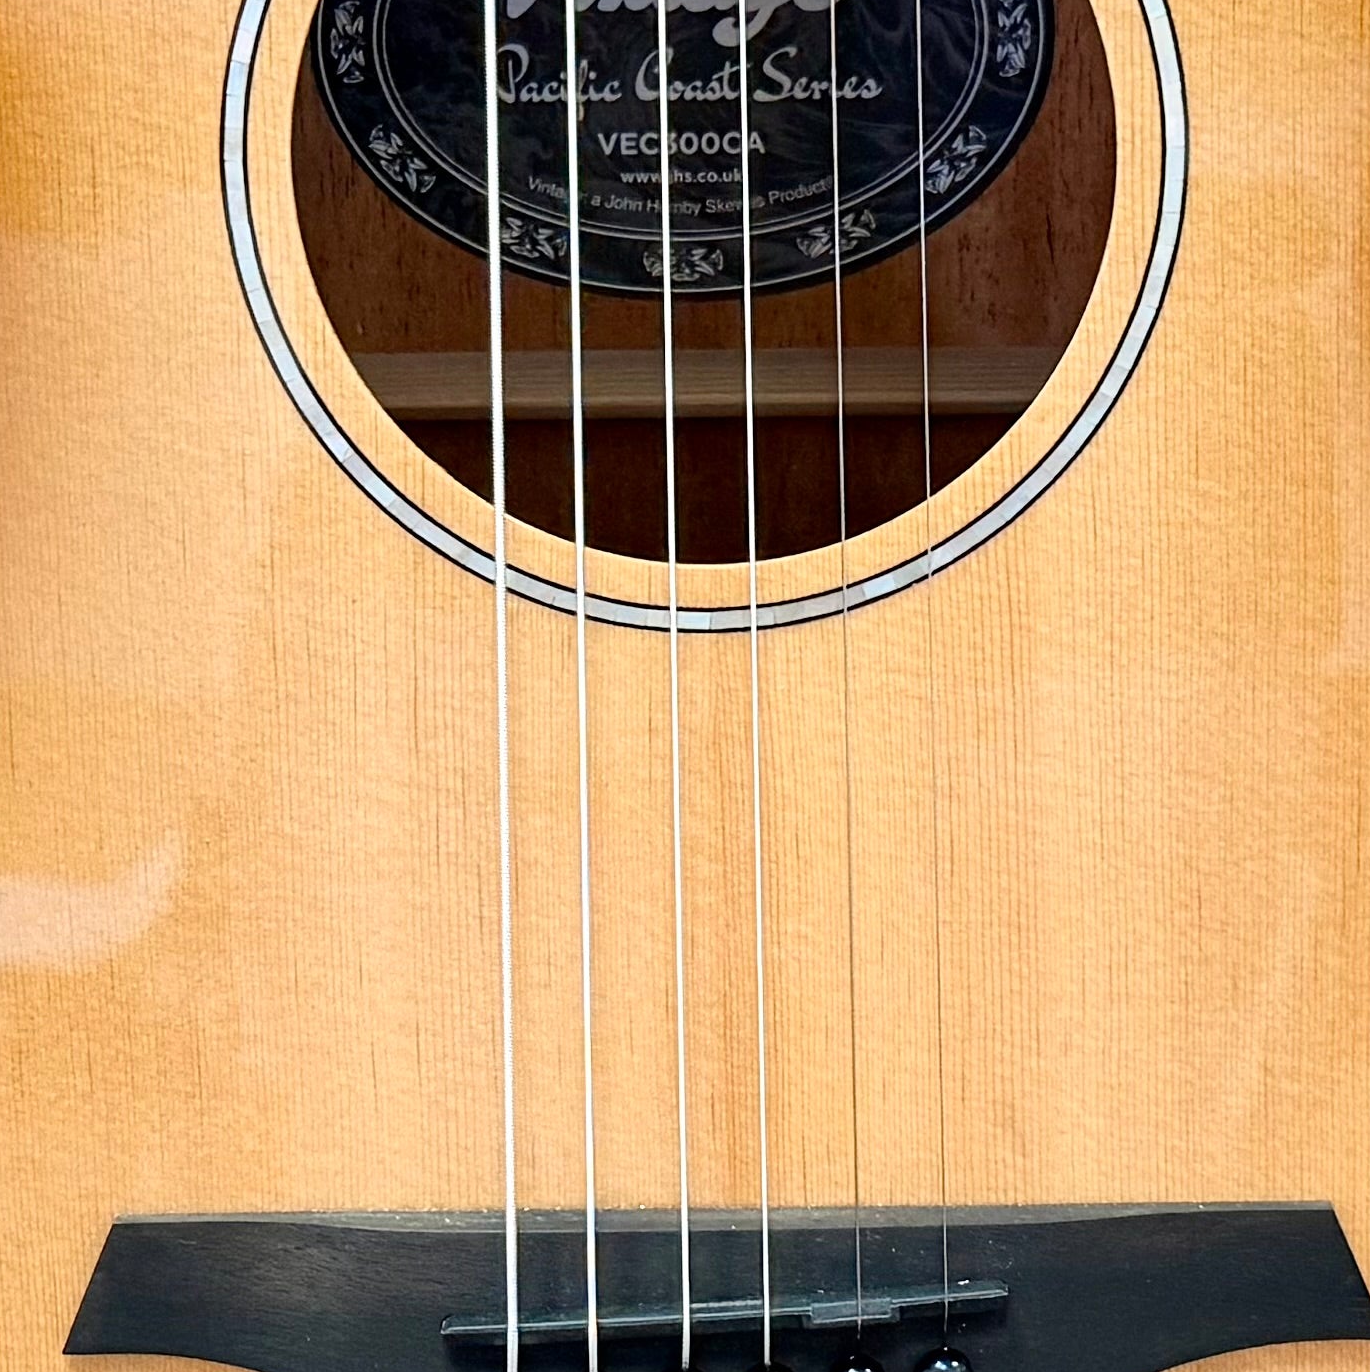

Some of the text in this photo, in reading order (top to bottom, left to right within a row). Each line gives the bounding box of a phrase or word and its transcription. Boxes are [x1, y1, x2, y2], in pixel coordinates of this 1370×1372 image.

[497, 43, 622, 121] Pacific
[635, 46, 753, 101] Coast
[528, 175, 577, 205] Vinta
[604, 194, 643, 213] John
[646, 198, 701, 217] Hnby
[620, 168, 743, 186] wwwhs.co.uk
